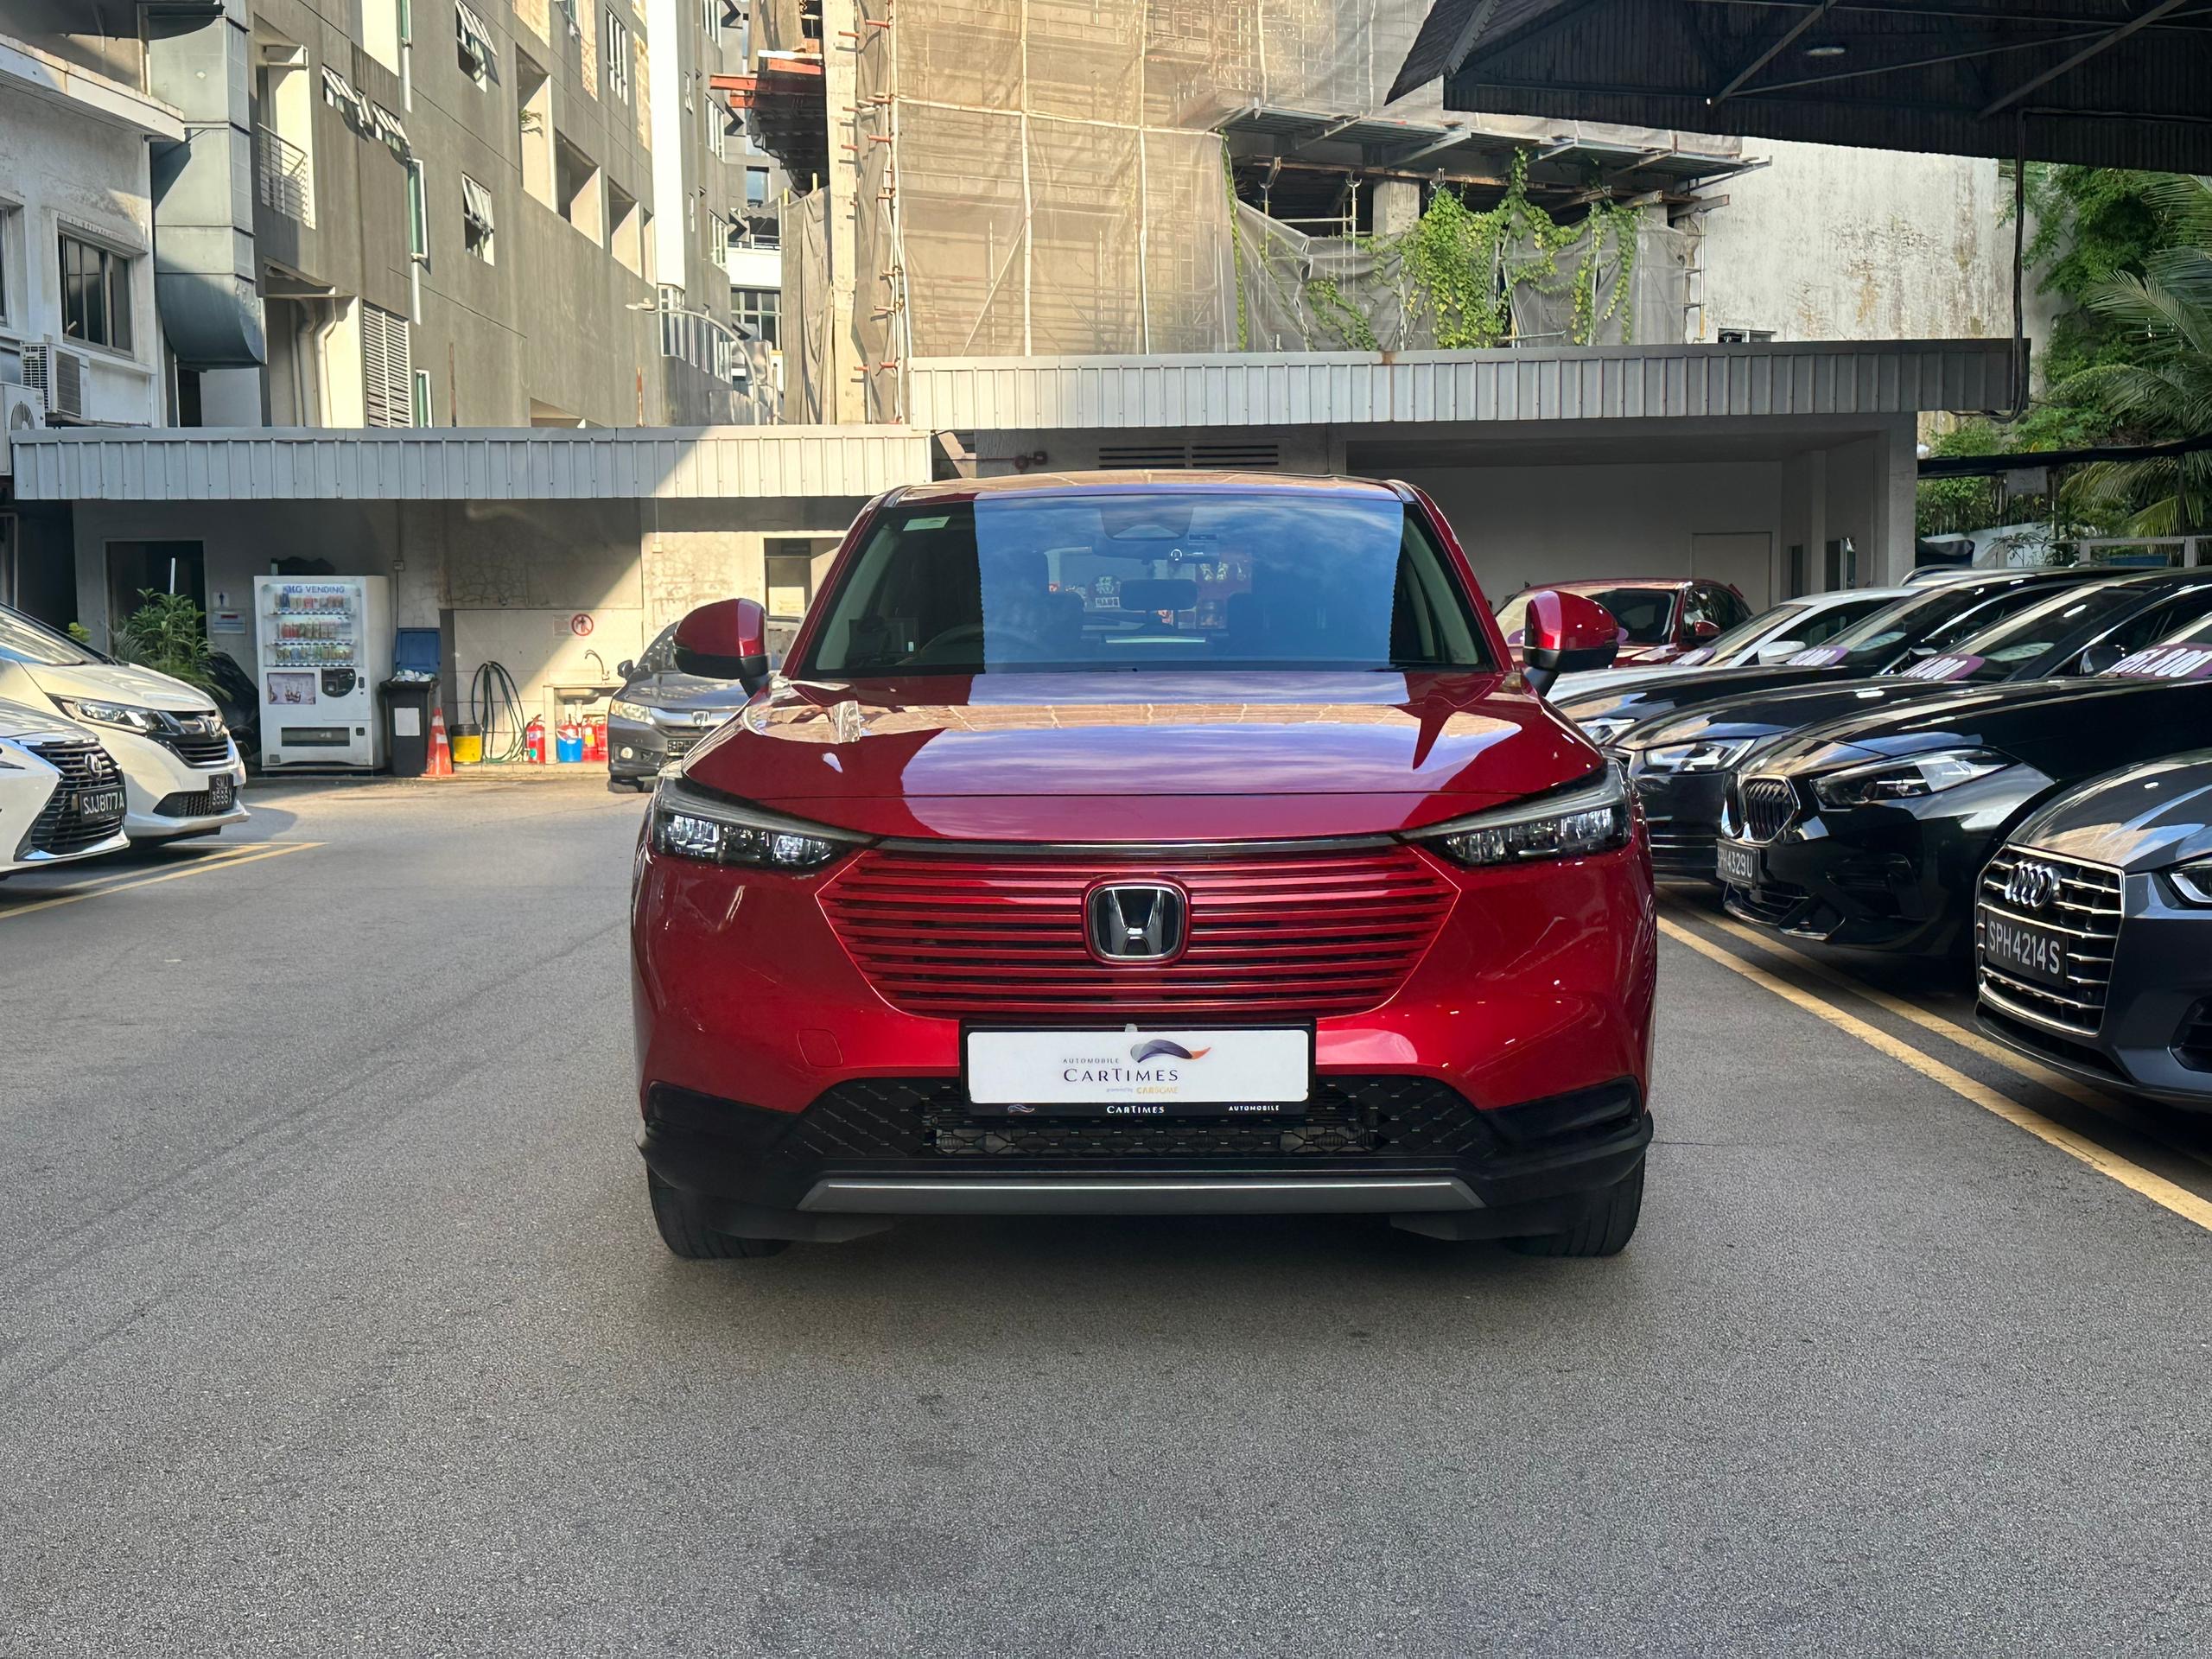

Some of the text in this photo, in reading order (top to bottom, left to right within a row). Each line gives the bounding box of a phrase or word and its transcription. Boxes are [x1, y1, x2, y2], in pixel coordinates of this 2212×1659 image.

[83, 791, 125, 815] SJJ8177A
[1989, 920, 2060, 975] SPH4214S
[1064, 1068, 1179, 1082] CARTIMES
[1106, 1105, 1165, 1114] CARTIMES
